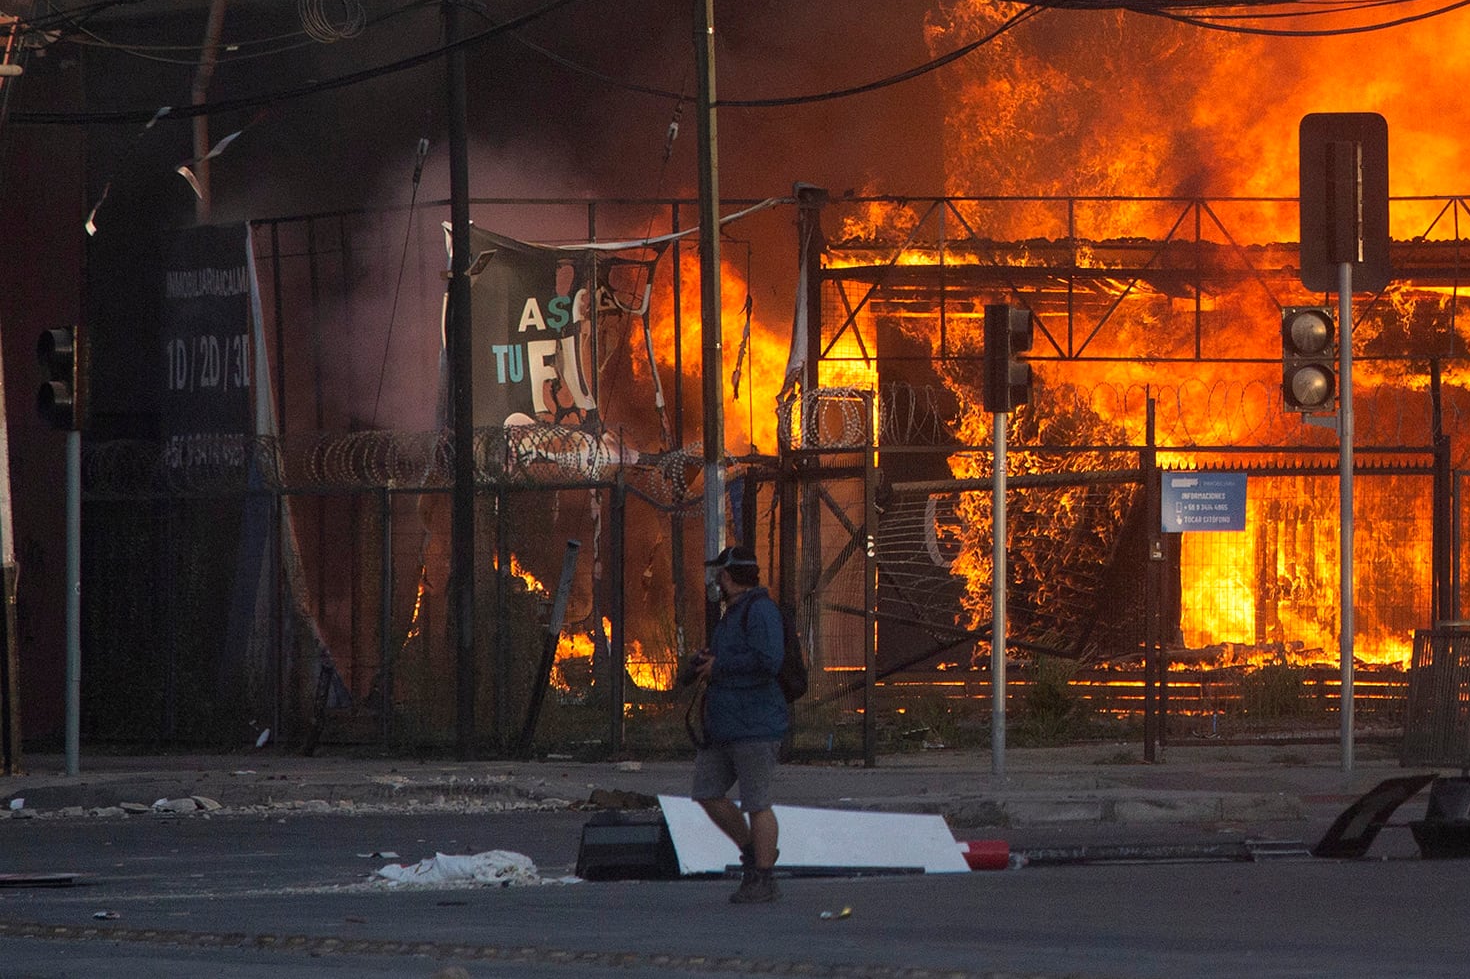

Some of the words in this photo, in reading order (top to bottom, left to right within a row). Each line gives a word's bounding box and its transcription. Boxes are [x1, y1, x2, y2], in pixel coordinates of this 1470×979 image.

[166, 338, 187, 390] 1D
[200, 335, 220, 387] 2D
[492, 344, 523, 383] TU
[1181, 492, 1226, 500] INFORMACIONES
